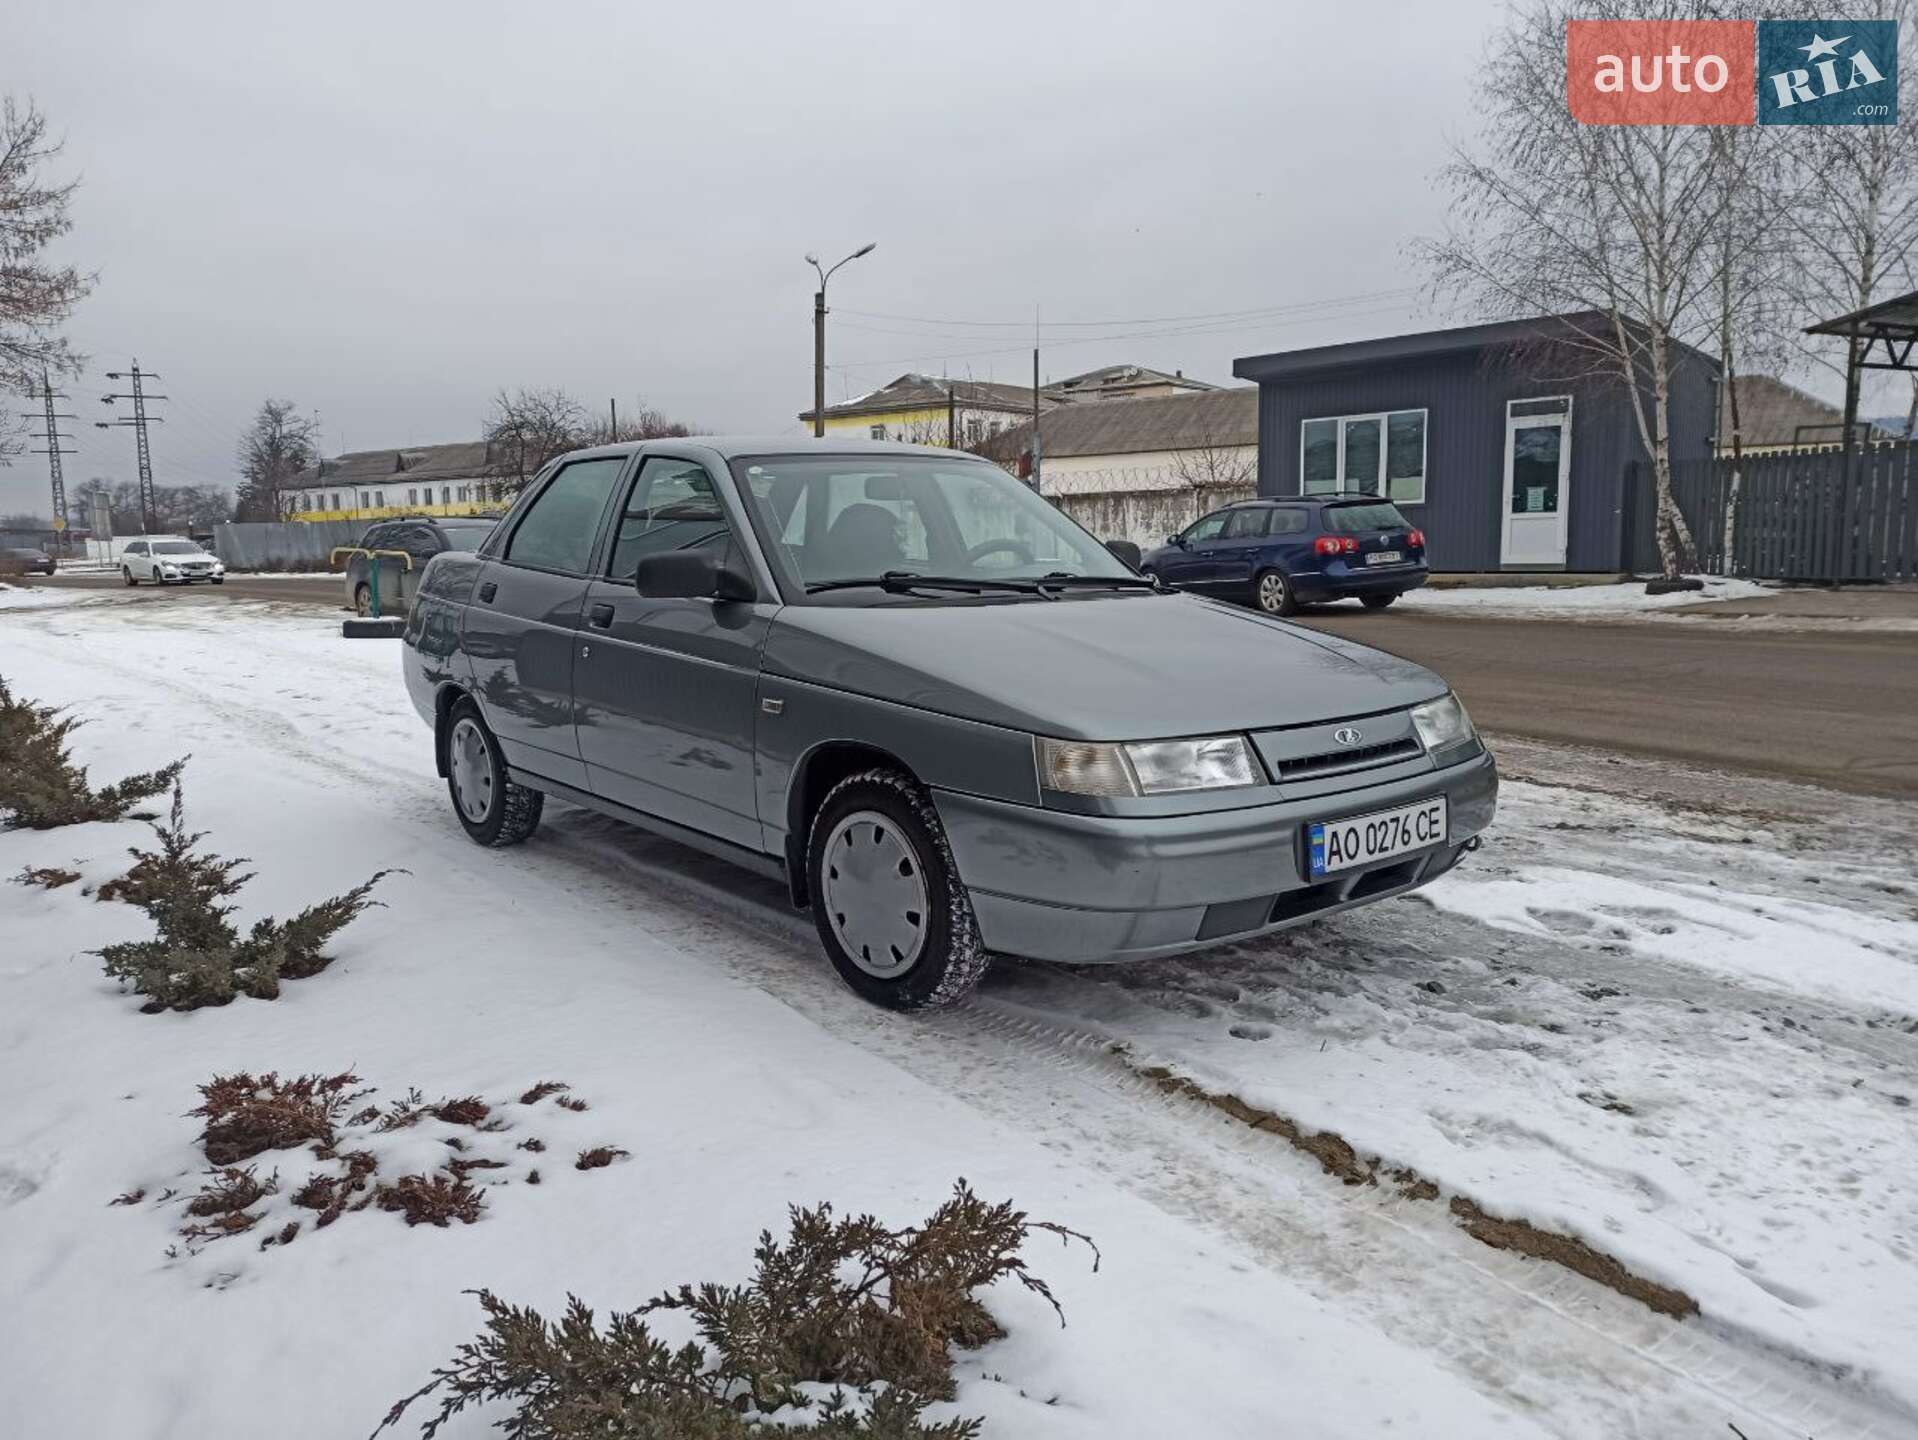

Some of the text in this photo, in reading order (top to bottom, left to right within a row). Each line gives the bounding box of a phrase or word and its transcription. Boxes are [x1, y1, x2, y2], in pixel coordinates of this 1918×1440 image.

[1327, 806, 1440, 866] AO 0276 CE
